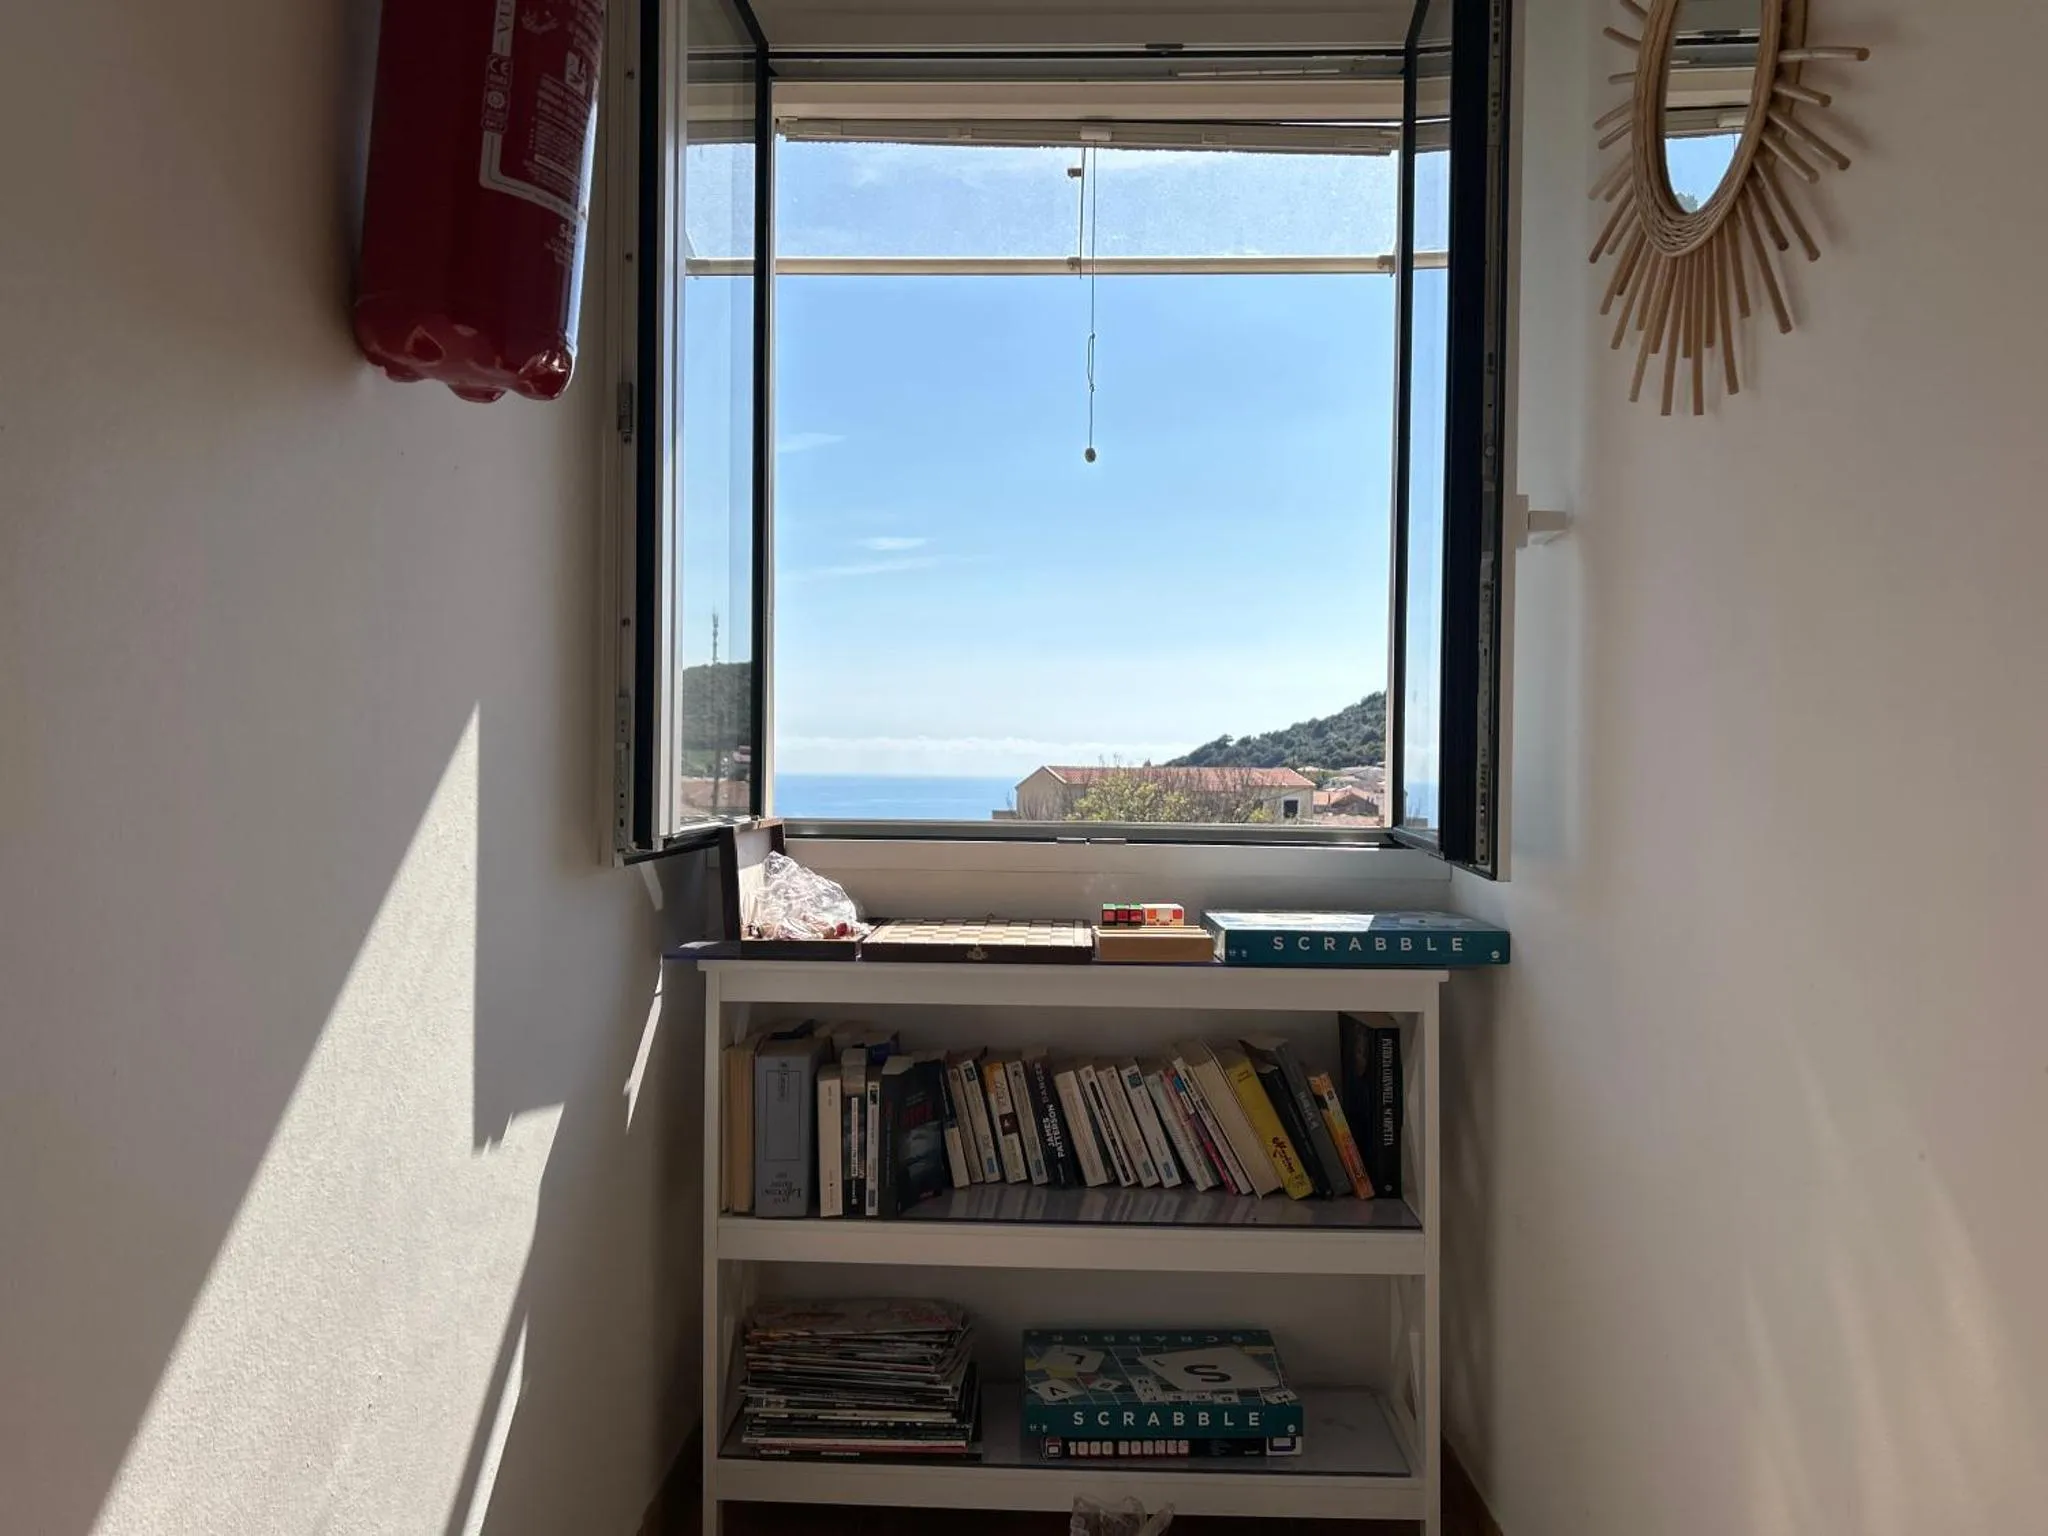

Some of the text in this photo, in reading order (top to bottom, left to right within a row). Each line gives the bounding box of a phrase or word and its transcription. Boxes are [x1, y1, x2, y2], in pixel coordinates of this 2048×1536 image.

[1272, 936, 1465, 951] SCRABBLE
[1042, 1117, 1055, 1148] JAMES
[1047, 1102, 1066, 1158] PATTERSON
[1072, 1411, 1261, 1427] SCRABBLE
